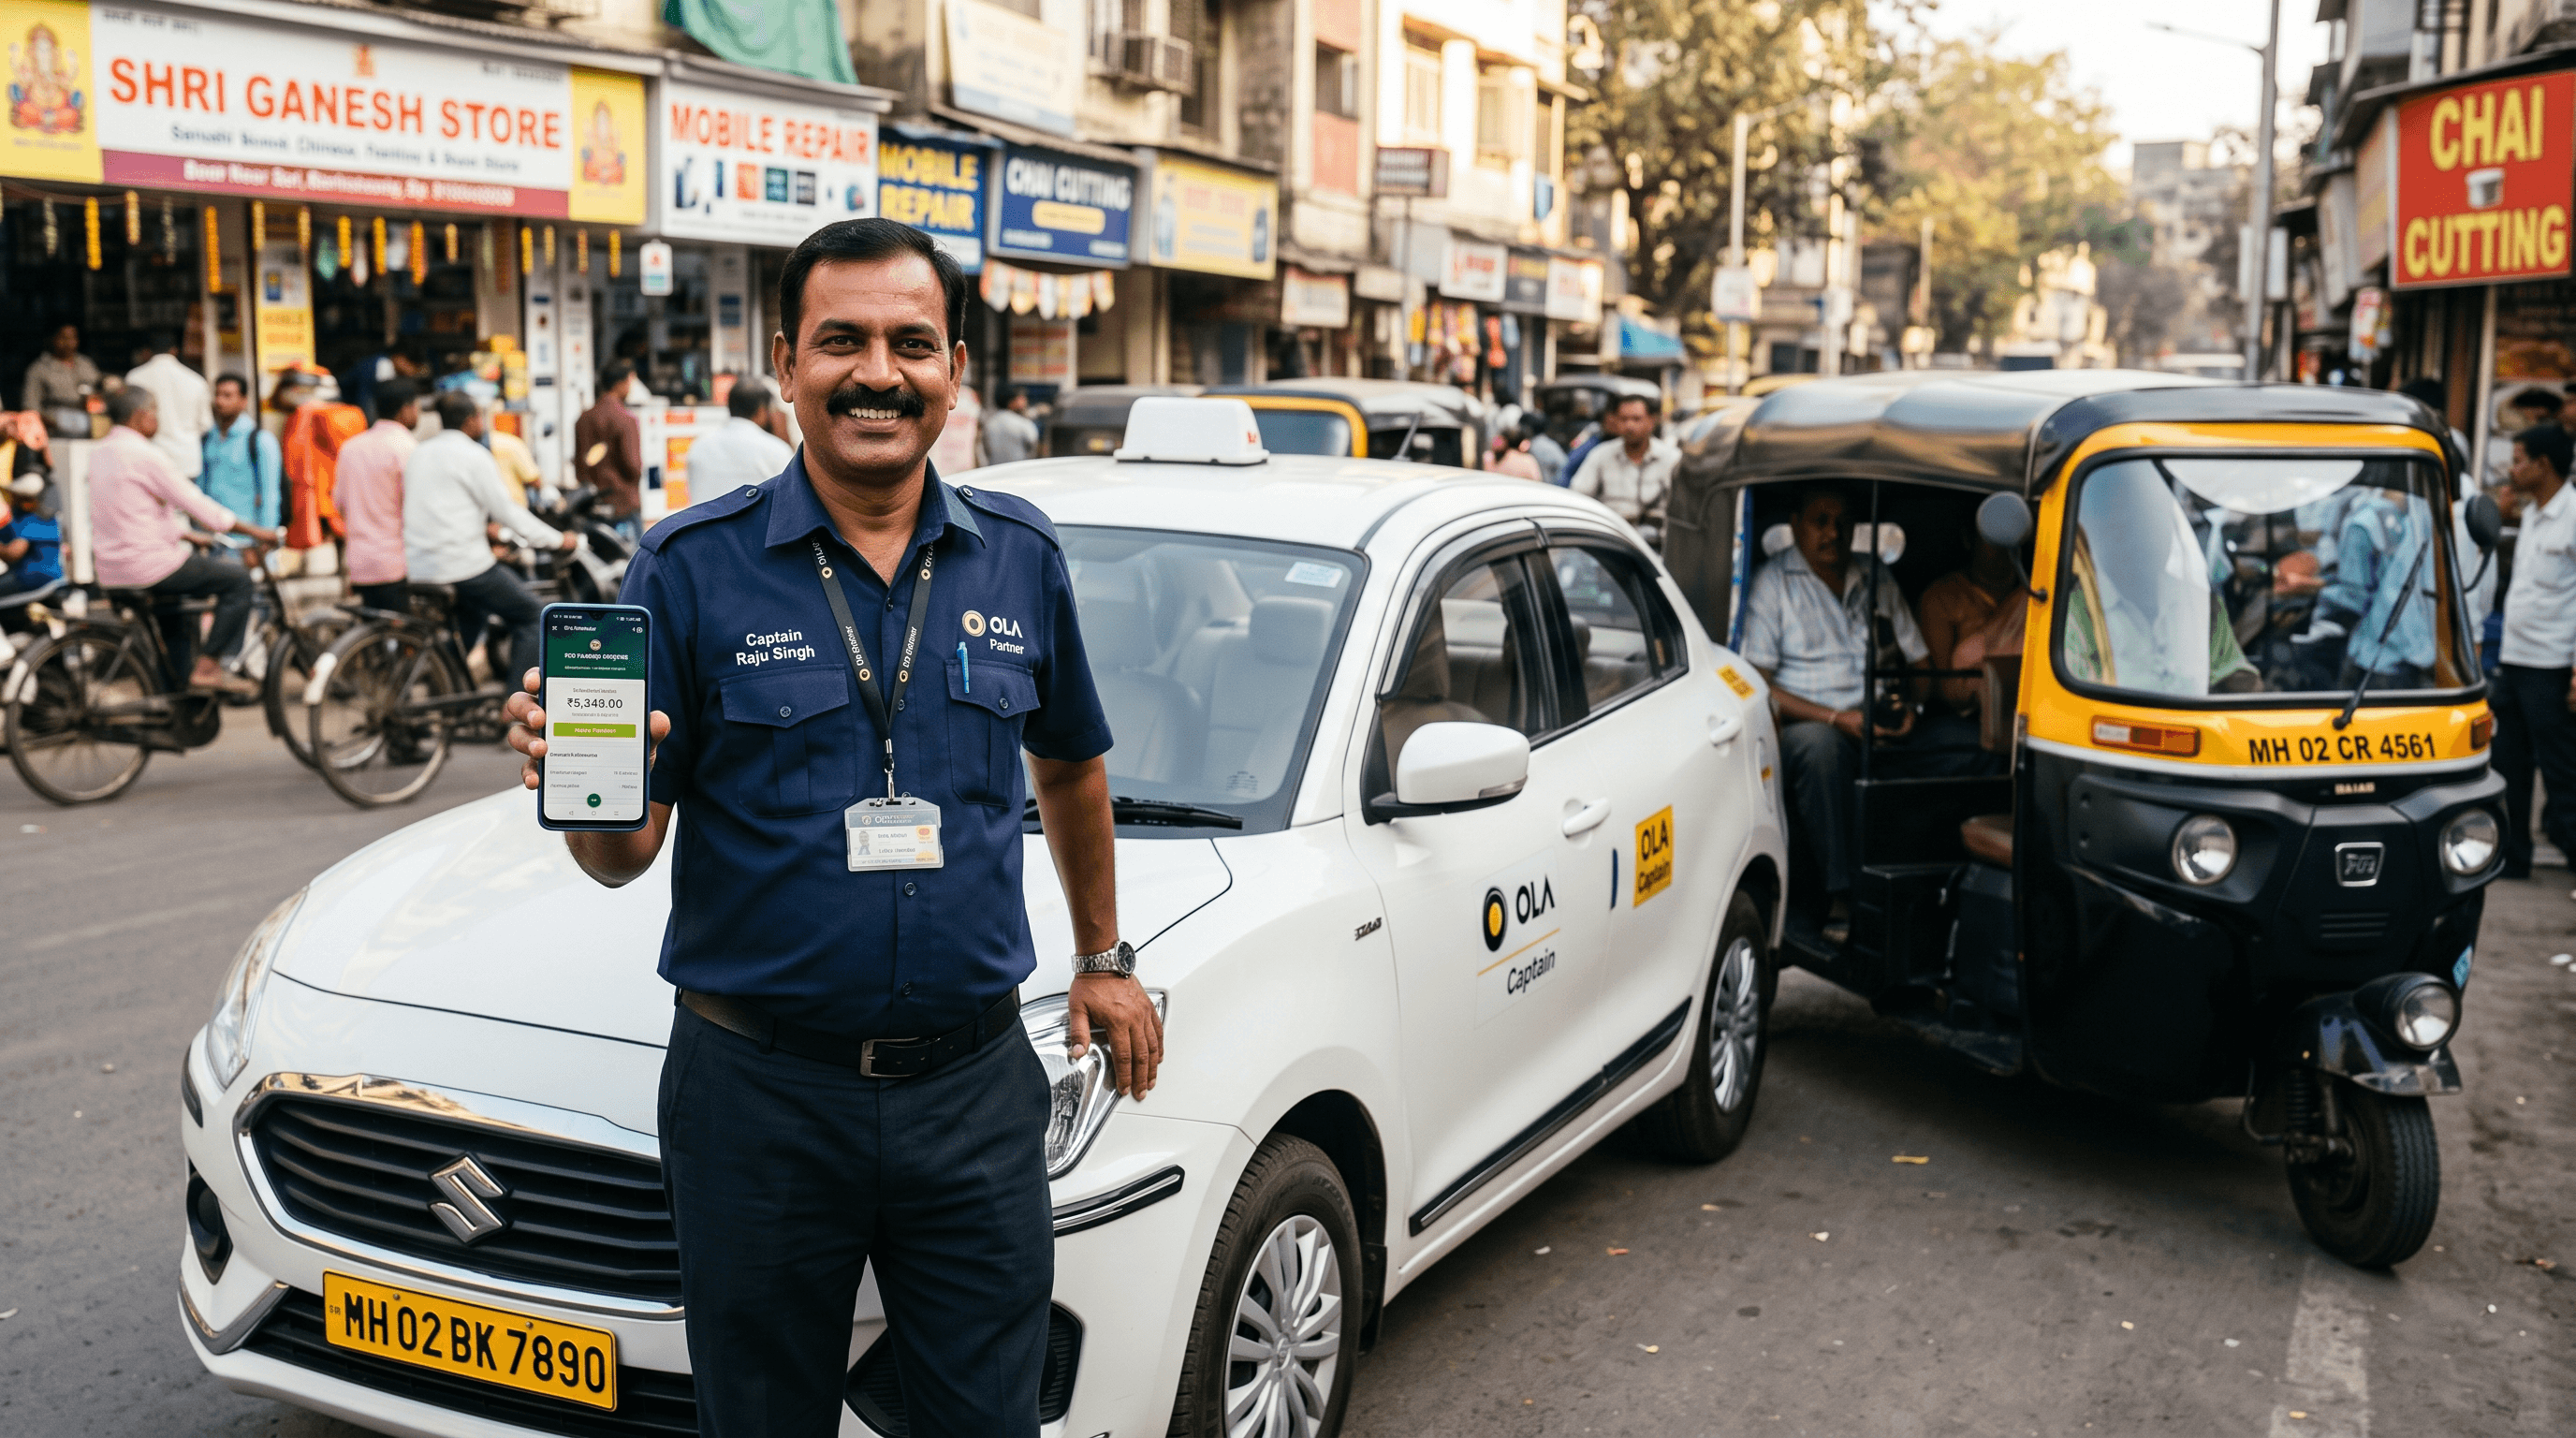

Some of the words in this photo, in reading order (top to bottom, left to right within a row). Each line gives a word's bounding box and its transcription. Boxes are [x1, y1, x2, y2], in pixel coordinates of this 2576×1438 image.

[110, 58, 226, 113] SHRI
[247, 75, 423, 134] GANESH
[441, 99, 561, 149] STORE
[671, 102, 773, 154] MOBILE
[783, 119, 870, 165] REPAIR
[2429, 84, 2545, 172] CHAI
[878, 141, 978, 191] MOBILE
[880, 184, 974, 232] REPAIR
[2404, 203, 2567, 279] CUTTING
[746, 629, 802, 647] Captain
[989, 616, 1023, 638] OLA
[989, 638, 1024, 654] Partner
[736, 651, 769, 667] Raju
[772, 645, 815, 661] Singh
[2248, 738, 2291, 763] MH
[2298, 736, 2331, 762] 02
[2338, 735, 2373, 760] CR
[2380, 732, 2436, 759] 4561
[1641, 818, 1669, 861] OLA
[1515, 874, 1555, 925] OLA
[1507, 947, 1556, 994] Captain
[344, 1291, 388, 1347] MH
[398, 1306, 443, 1358] 02
[450, 1315, 497, 1372] BK
[506, 1328, 606, 1394] 7890
